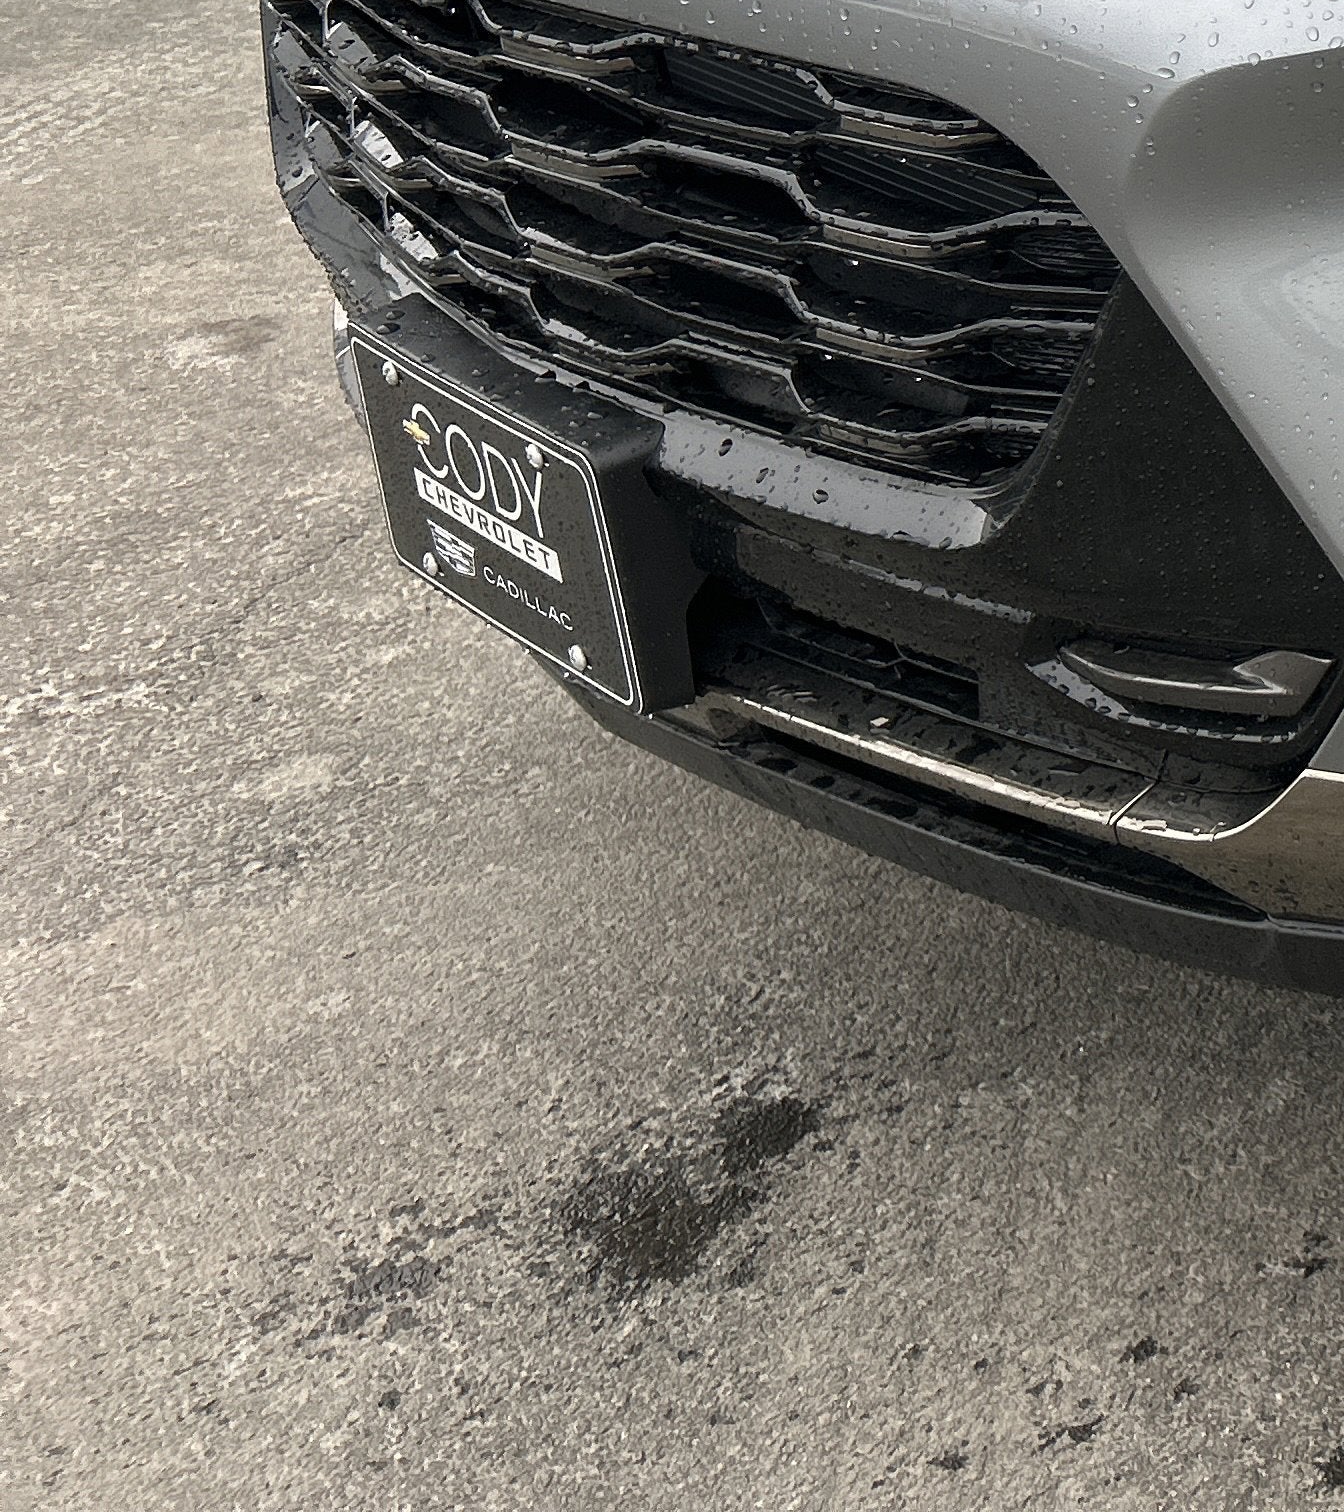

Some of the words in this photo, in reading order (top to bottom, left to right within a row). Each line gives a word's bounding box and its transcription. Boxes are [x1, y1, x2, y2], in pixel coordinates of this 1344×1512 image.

[409, 404, 544, 538] CODY
[424, 477, 553, 571] CHEVROLET
[483, 566, 574, 631] CADILLAC
